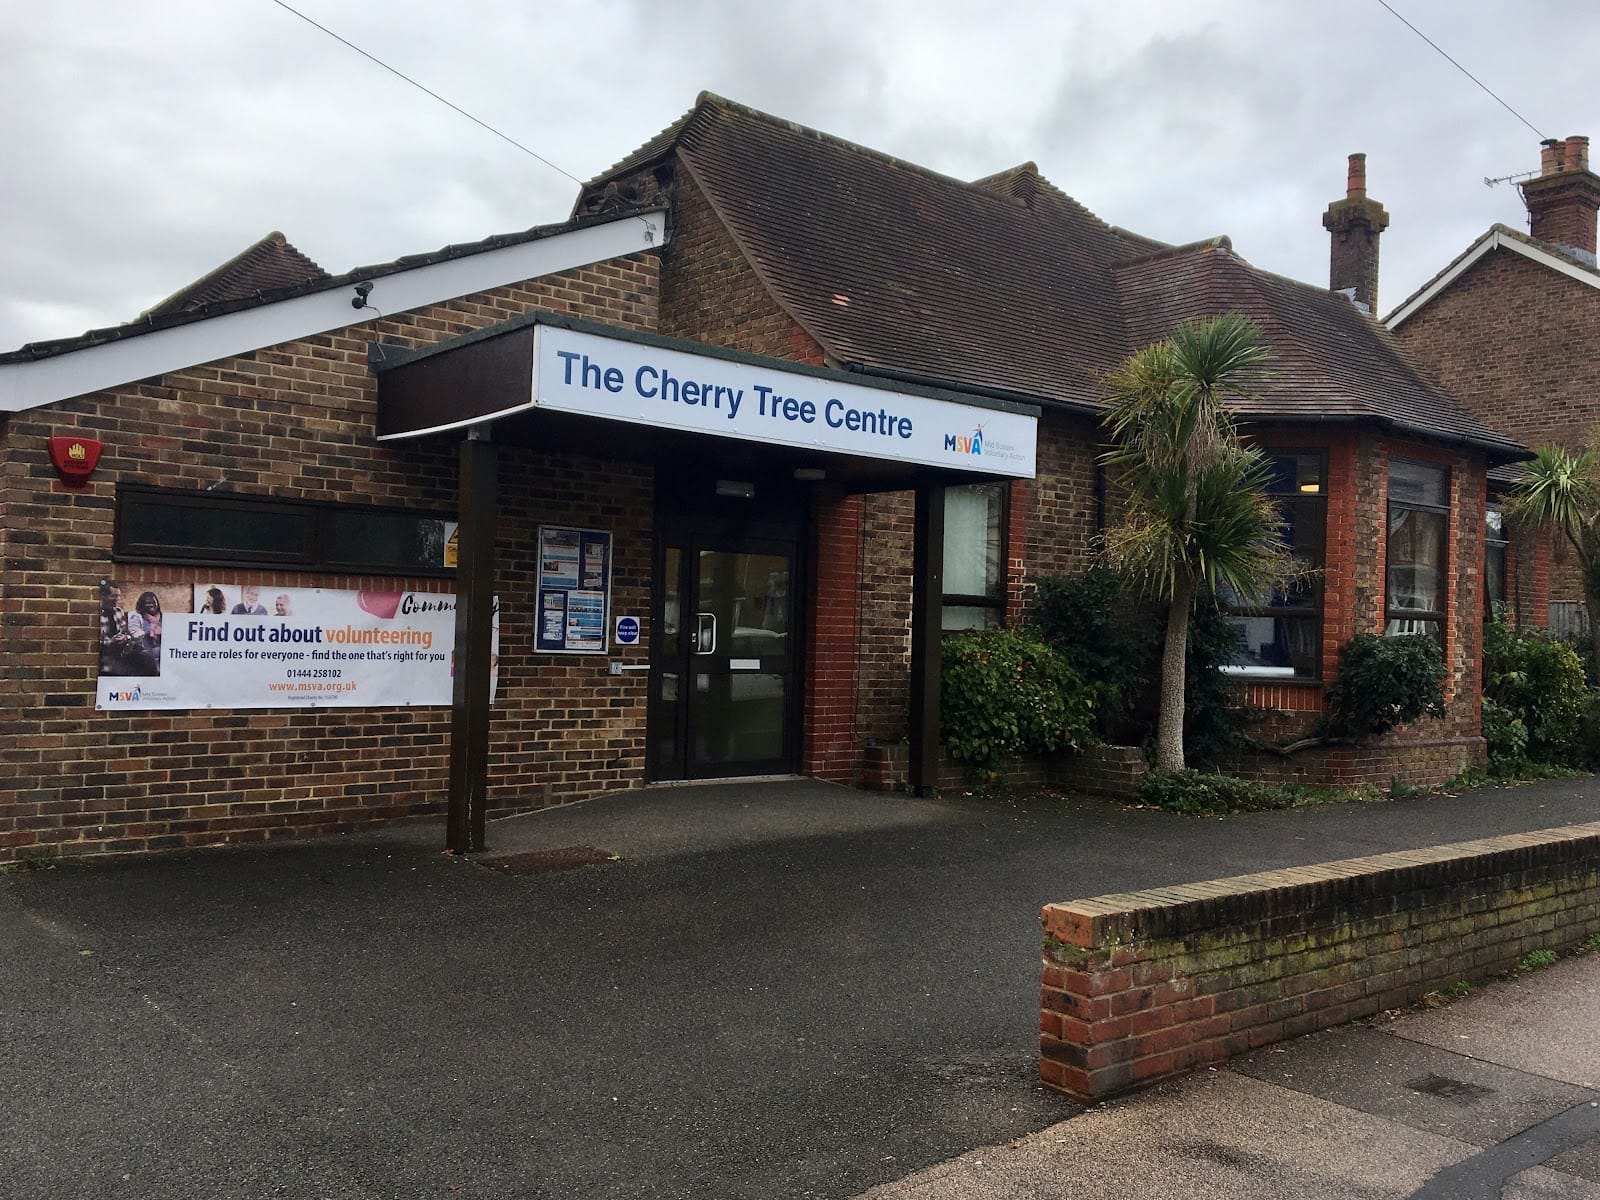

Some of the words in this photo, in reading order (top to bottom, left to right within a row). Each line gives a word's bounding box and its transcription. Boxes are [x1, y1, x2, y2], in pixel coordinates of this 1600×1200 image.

[557, 350, 624, 393] The
[635, 365, 744, 419] Cherry
[753, 385, 816, 423] Tree
[825, 399, 913, 439] Centre
[944, 429, 982, 455] MSVA
[188, 621, 229, 642] Find
[233, 625, 265, 643] out
[268, 623, 322, 643] about
[325, 624, 433, 650] volunteering
[169, 648, 198, 659] There
[200, 650, 217, 659] are
[218, 649, 243, 660] roles
[244, 649, 259, 659] for
[260, 651, 304, 662] everyone
[311, 649, 330, 660] find
[332, 650, 346, 660] the
[348, 652, 365, 661] one
[366, 651, 392, 661] that's
[393, 651, 414, 663] right
[415, 651, 428, 661] for
[429, 653, 445, 663] you
[287, 669, 311, 678] 01444
[313, 669, 342, 678] 258102
[109, 688, 141, 701] MSVA
[268, 681, 357, 693] www.msva.org.uk
